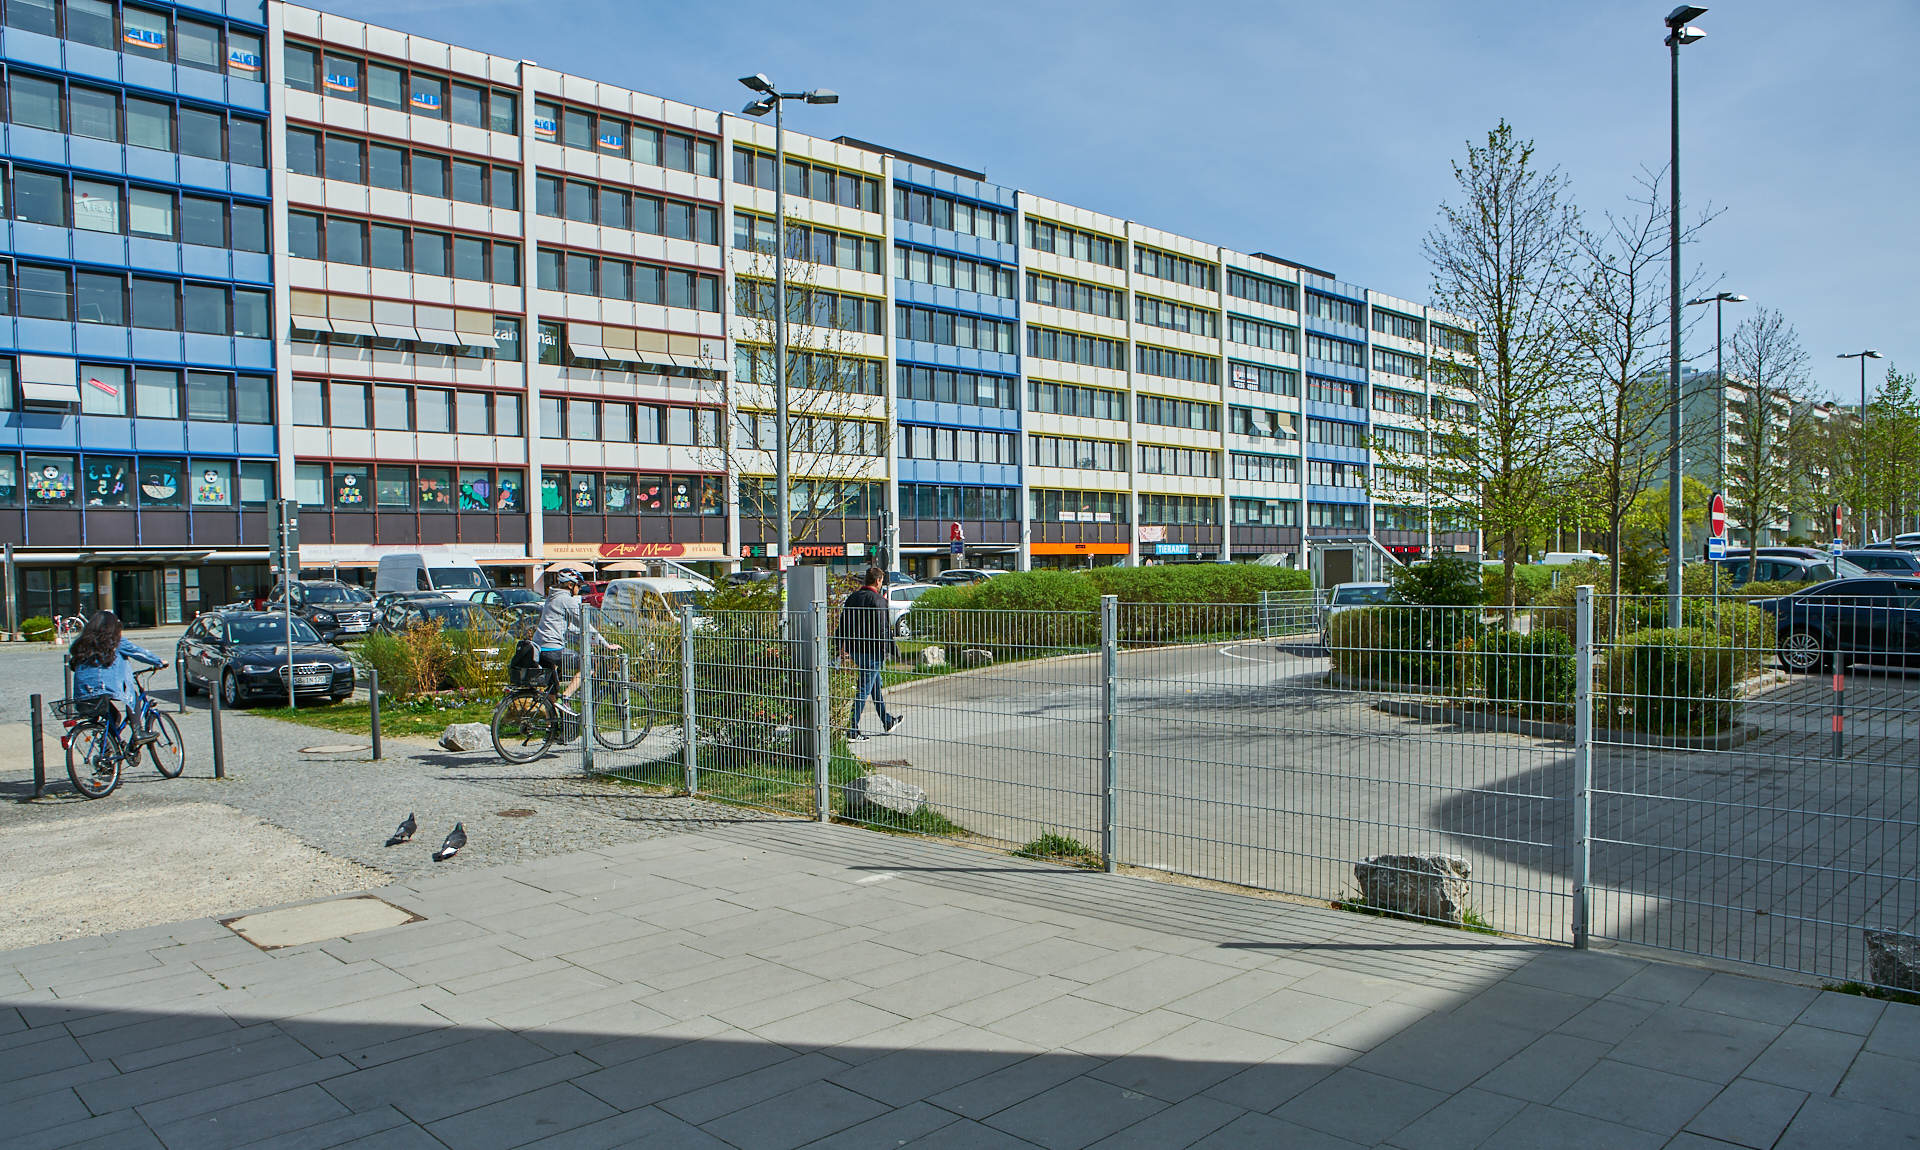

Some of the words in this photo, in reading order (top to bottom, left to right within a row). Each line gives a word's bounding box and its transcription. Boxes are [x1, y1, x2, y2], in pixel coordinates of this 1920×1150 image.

[127, 27, 162, 45] AKB
[327, 73, 355, 88] AKB
[412, 92, 439, 106] AKB
[791, 546, 844, 557] APOTHEKE
[1157, 545, 1187, 554] TIERARZT
